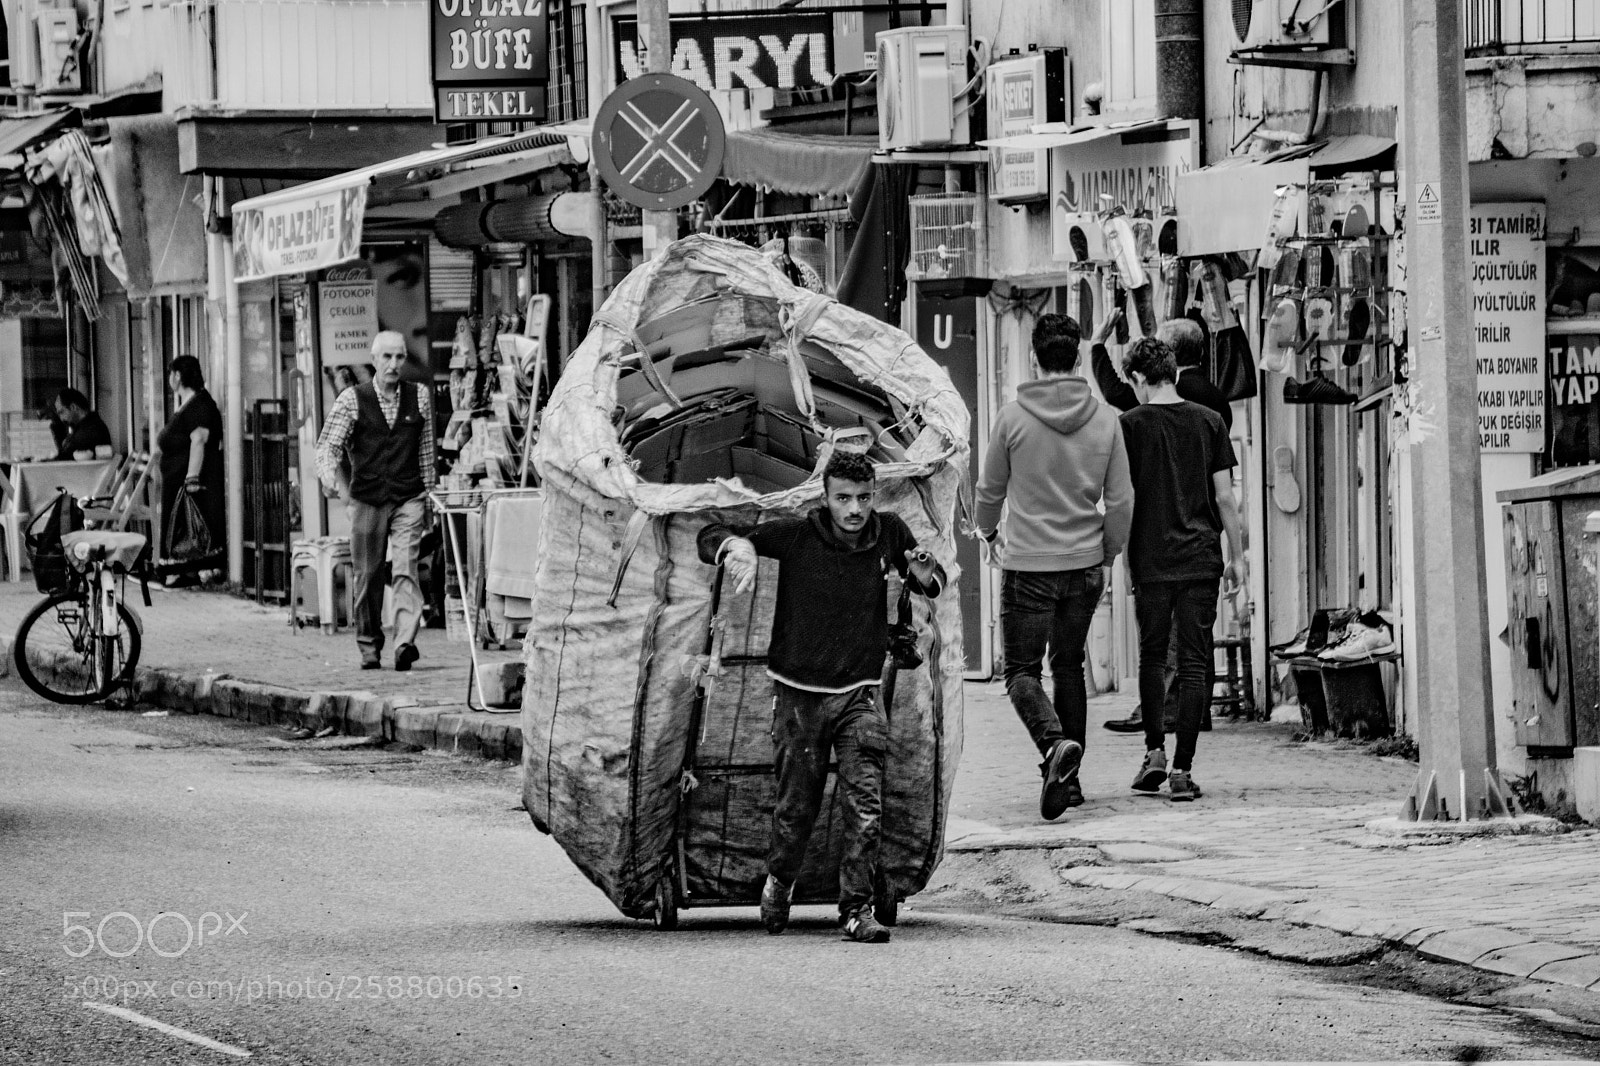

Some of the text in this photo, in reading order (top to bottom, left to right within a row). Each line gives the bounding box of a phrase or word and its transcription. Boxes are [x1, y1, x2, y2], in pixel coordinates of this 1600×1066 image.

[450, 19, 533, 71] BÜFE
[448, 90, 535, 117] TEKEL
[1081, 167, 1144, 213] MARMARA
[267, 200, 336, 252] OFLAZ BÜFE
[323, 286, 374, 299] FOTOKOPİ
[329, 304, 367, 318] ÇEKİLİR
[334, 329, 369, 339] EKMEK
[1474, 322, 1511, 343] İRİLİR
[1476, 357, 1538, 375] NTA BOYANIR
[1549, 345, 1600, 375] TAM
[1508, 389, 1544, 407] YAPILIR
[1551, 375, 1600, 406] YAP
[1500, 411, 1542, 434] DEĞİŞİR
